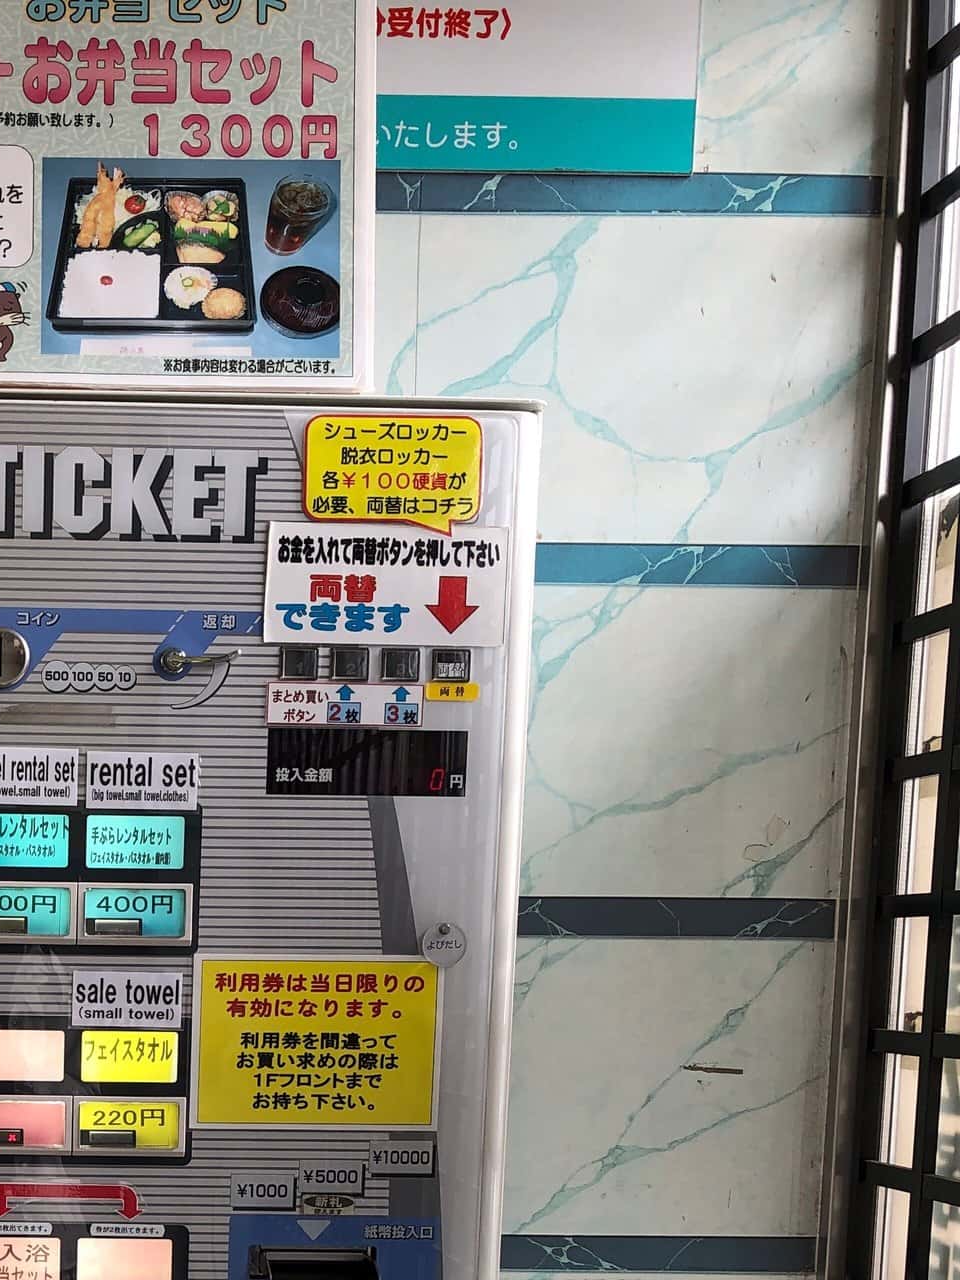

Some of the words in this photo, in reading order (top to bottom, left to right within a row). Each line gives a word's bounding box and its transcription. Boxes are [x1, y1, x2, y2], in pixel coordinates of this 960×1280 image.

[376, 7, 512, 40] 受付終了〉
[144, 114, 337, 159] 1300円
[324, 423, 467, 442] シューズロッカー
[341, 448, 448, 466] 脱衣ロッカー
[312, 497, 473, 515] 必要、両替はコチラ
[278, 535, 499, 568] お金を入れて両替ボタンを押して下さい
[310, 574, 376, 602] 両替
[16, 611, 60, 625] コイン
[202, 615, 236, 629] 返却
[275, 602, 409, 633] できます
[45, 670, 69, 682] 500
[72, 670, 93, 682] 100
[97, 671, 114, 682] 50
[118, 671, 131, 683] 10
[272, 690, 329, 704] まとめ買い
[284, 710, 315, 722] ボタン
[11, 755, 48, 782] rental
[54, 756, 75, 783] set
[91, 757, 152, 787] rental
[162, 758, 196, 788] set
[276, 768, 332, 782] 投入金額
[450, 775, 464, 789] 円
[91, 826, 171, 845] 手ぶらレンタルセット
[96, 896, 173, 914] 400円
[76, 978, 116, 1005] sale
[126, 979, 179, 1005] towel
[215, 972, 425, 993] 利用券は当日限りの
[78, 1007, 122, 1020] (small
[129, 1007, 174, 1020] towel)
[226, 999, 401, 1019] 有効になります。
[240, 1032, 397, 1049] 利用券を間違って
[85, 1038, 173, 1062] フェイスタオル
[236, 1053, 399, 1070] お買い求めの際は
[254, 1073, 382, 1089] 1Fフロントまで
[252, 1093, 375, 1110] お持ち下さい。
[93, 1109, 165, 1127] 220円
[373, 1150, 430, 1165] ¥10000
[304, 1169, 358, 1184] ¥5000
[238, 1184, 288, 1198] ¥1000
[364, 1225, 433, 1239] 紙幣投入口
